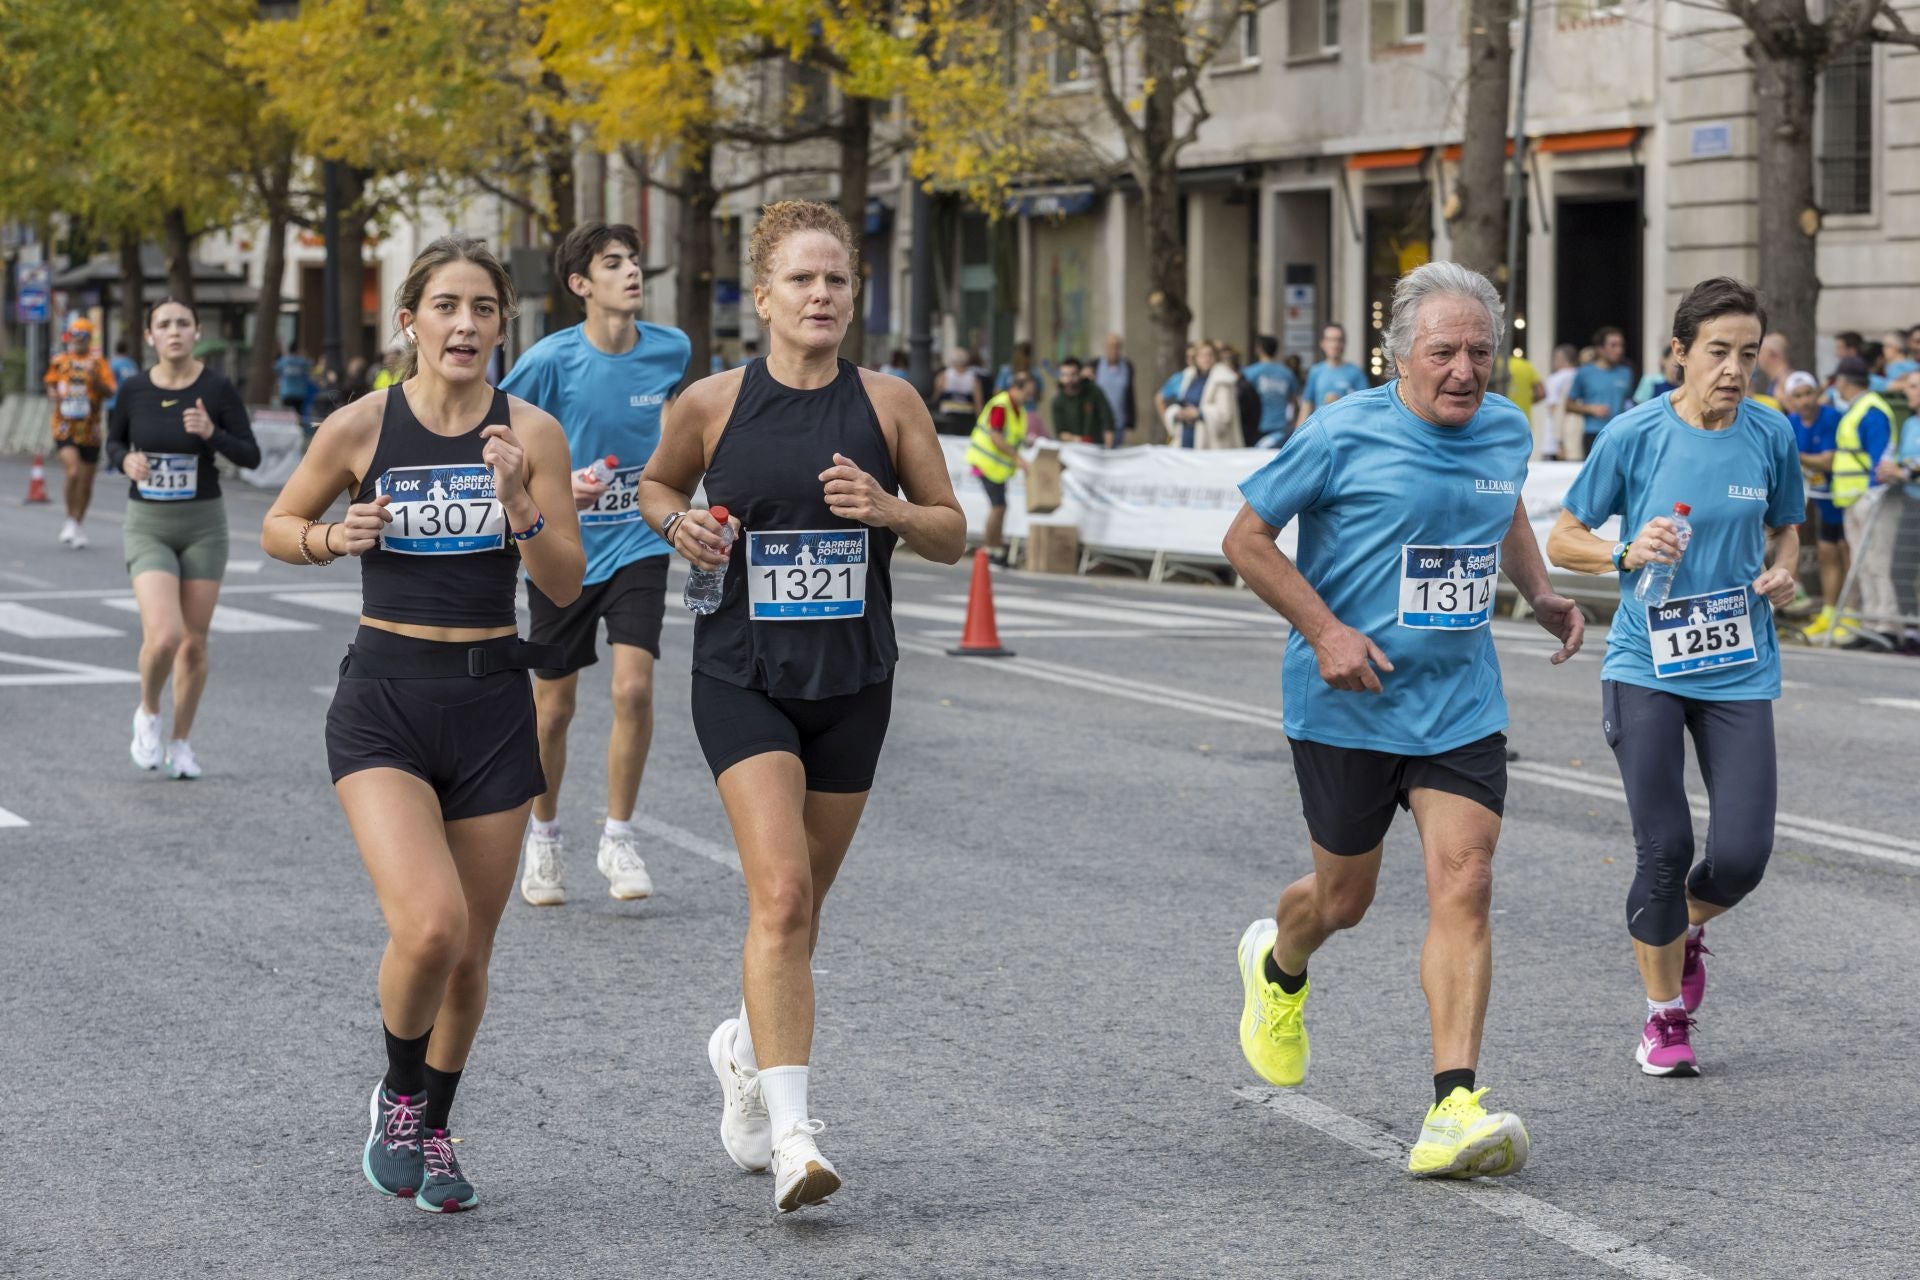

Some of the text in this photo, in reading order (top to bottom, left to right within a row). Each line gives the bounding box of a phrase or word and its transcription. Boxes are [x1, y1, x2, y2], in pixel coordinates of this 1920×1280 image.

[147, 473, 188, 488] 1213
[395, 480, 420, 492] 10K
[449, 482, 496, 491] POPULAR
[1475, 479, 1488, 490] EL
[1728, 485, 1741, 495] EL
[395, 502, 492, 537] 1307
[764, 544, 789, 555] 10K
[818, 540, 863, 549] CARRERA
[817, 547, 863, 556] POPULAR
[847, 555, 861, 563] DM
[1419, 558, 1443, 569] 10K
[764, 567, 852, 601] 1321
[1417, 578, 1490, 612] 1314
[1706, 594, 1745, 608] CARRERA
[1658, 607, 1682, 621] 10K
[1706, 601, 1745, 615] POPULAR
[1668, 622, 1740, 658] 1253
